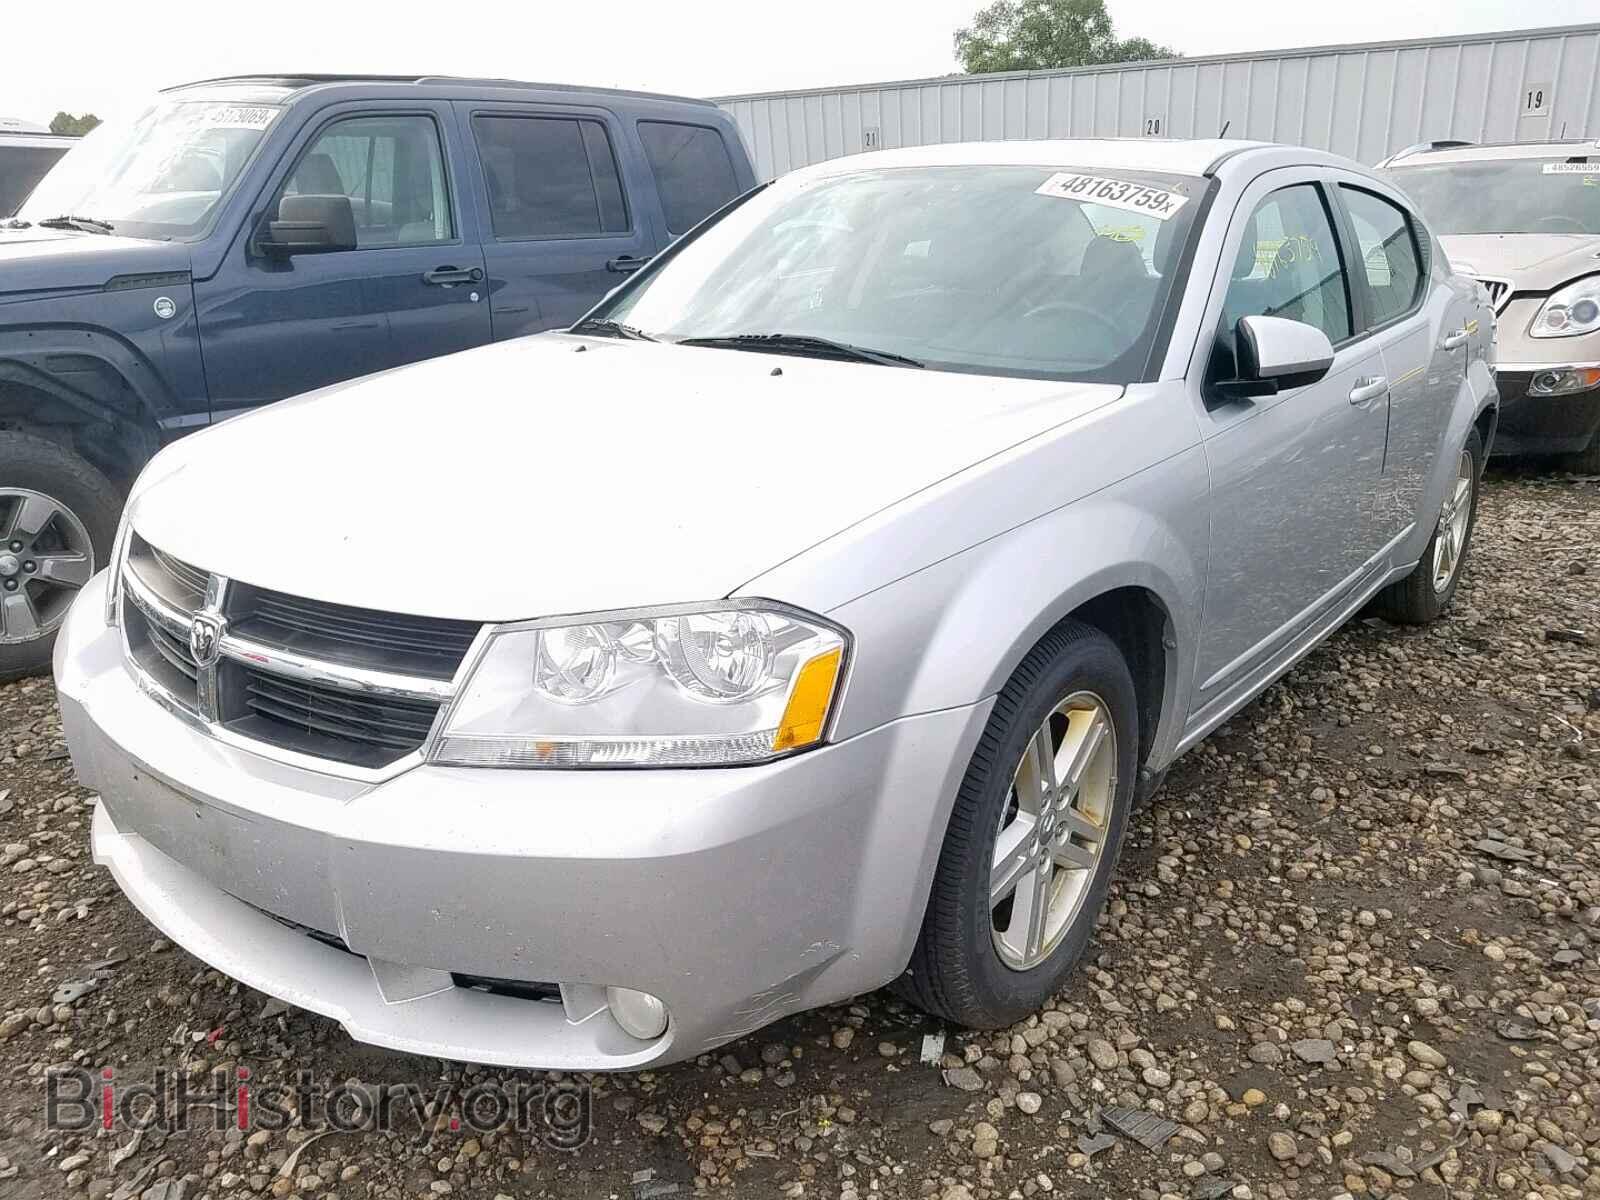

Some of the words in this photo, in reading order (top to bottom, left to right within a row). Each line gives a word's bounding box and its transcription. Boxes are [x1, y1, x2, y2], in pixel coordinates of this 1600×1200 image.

[1527, 90, 1543, 109] 19
[1146, 119, 1160, 135] 20
[865, 132, 876, 146] 21
